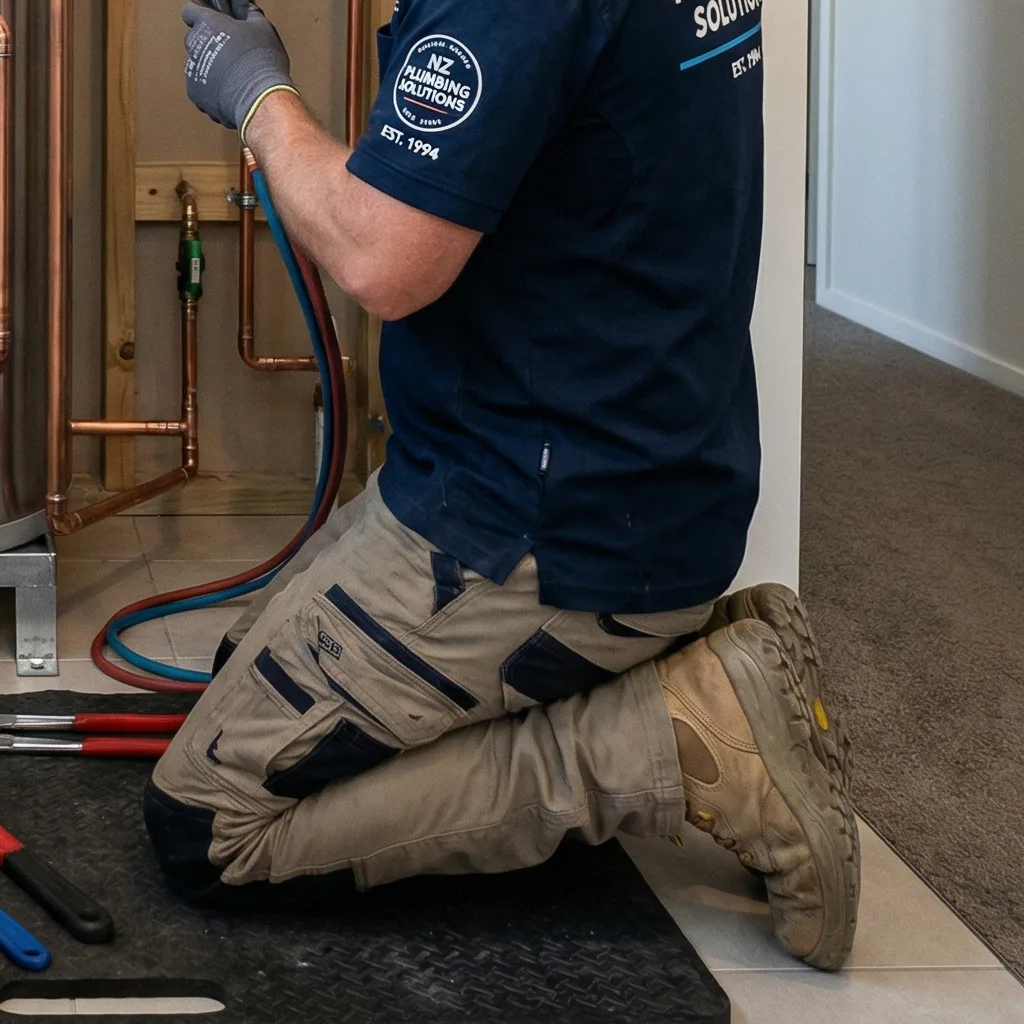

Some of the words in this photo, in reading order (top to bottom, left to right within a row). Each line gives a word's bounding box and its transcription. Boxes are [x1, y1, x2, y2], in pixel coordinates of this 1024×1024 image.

[404, 64, 471, 99] PLUMBING
[426, 53, 455, 75] NZ
[380, 124, 405, 146] EST.
[407, 137, 440, 160] 1994
